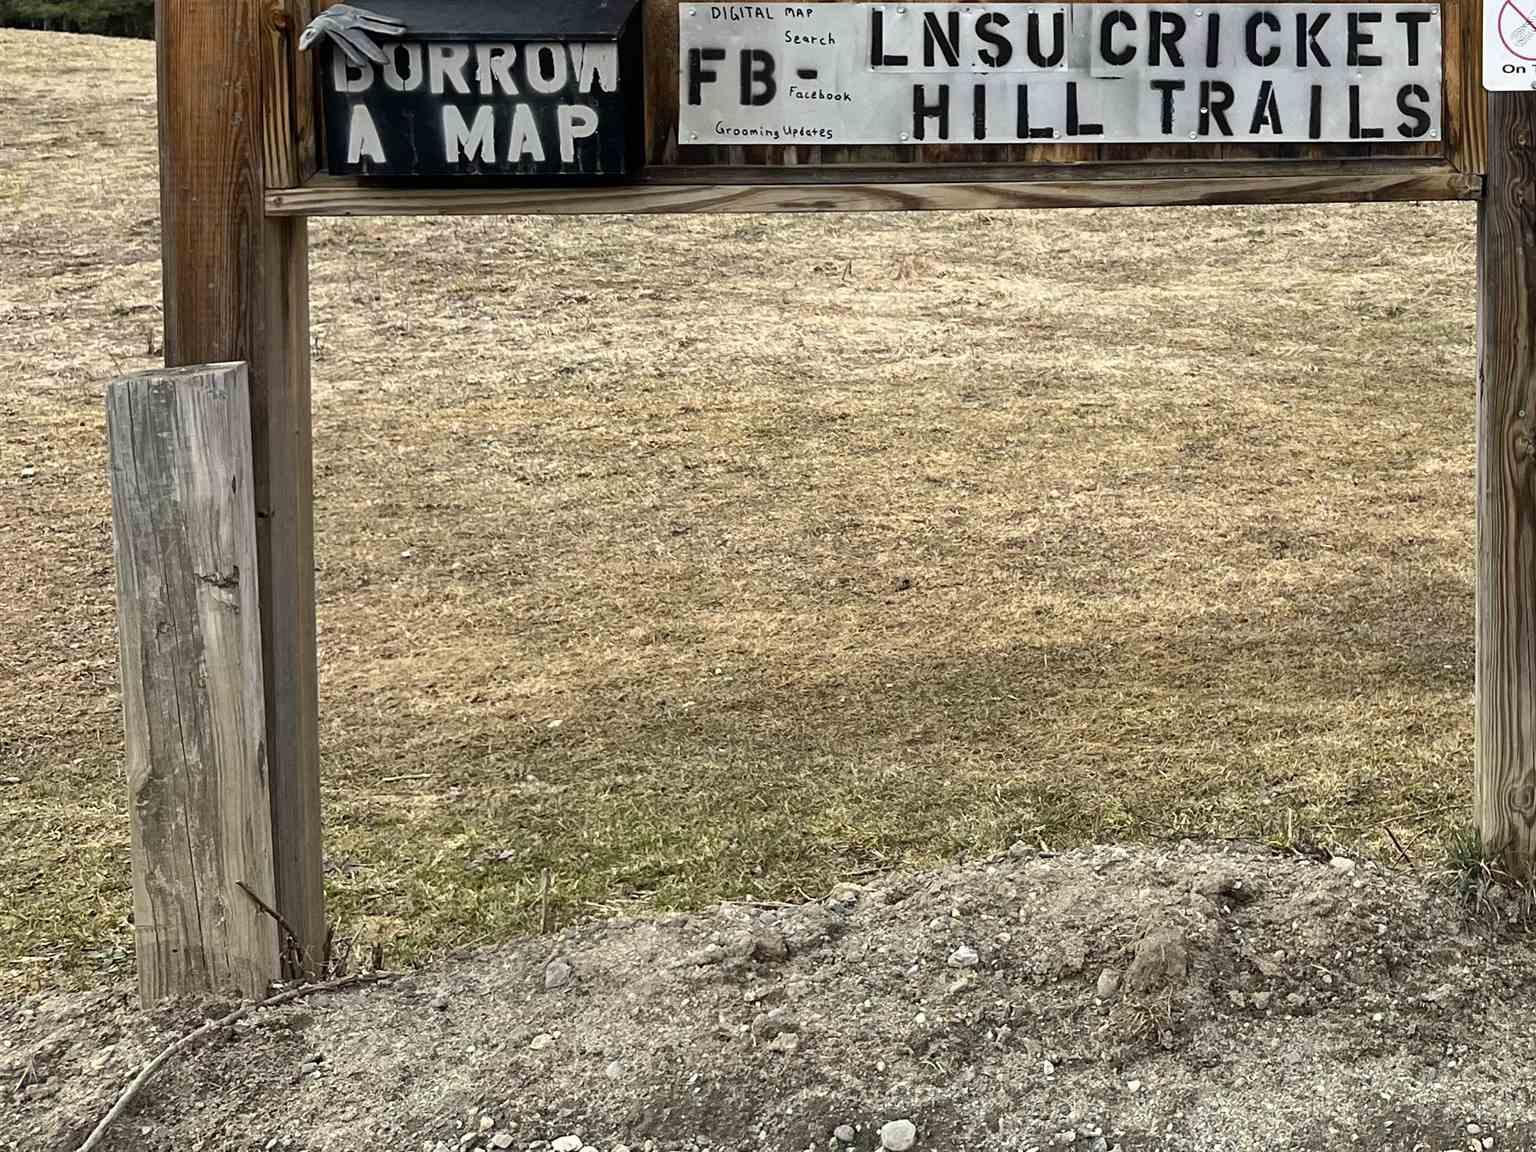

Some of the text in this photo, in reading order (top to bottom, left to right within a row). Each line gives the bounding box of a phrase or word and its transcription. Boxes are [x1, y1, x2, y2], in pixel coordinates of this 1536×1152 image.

[712, 6, 815, 20] DIGITAL MAP
[784, 30, 836, 46] Search
[871, 9, 1430, 68] LNSU CRICKET
[1502, 65, 1526, 74] On
[790, 86, 851, 102] Facebook
[913, 79, 1430, 140] HILL TRAILS
[347, 104, 599, 163] A MAP
[715, 122, 832, 139] Grooming Updates
